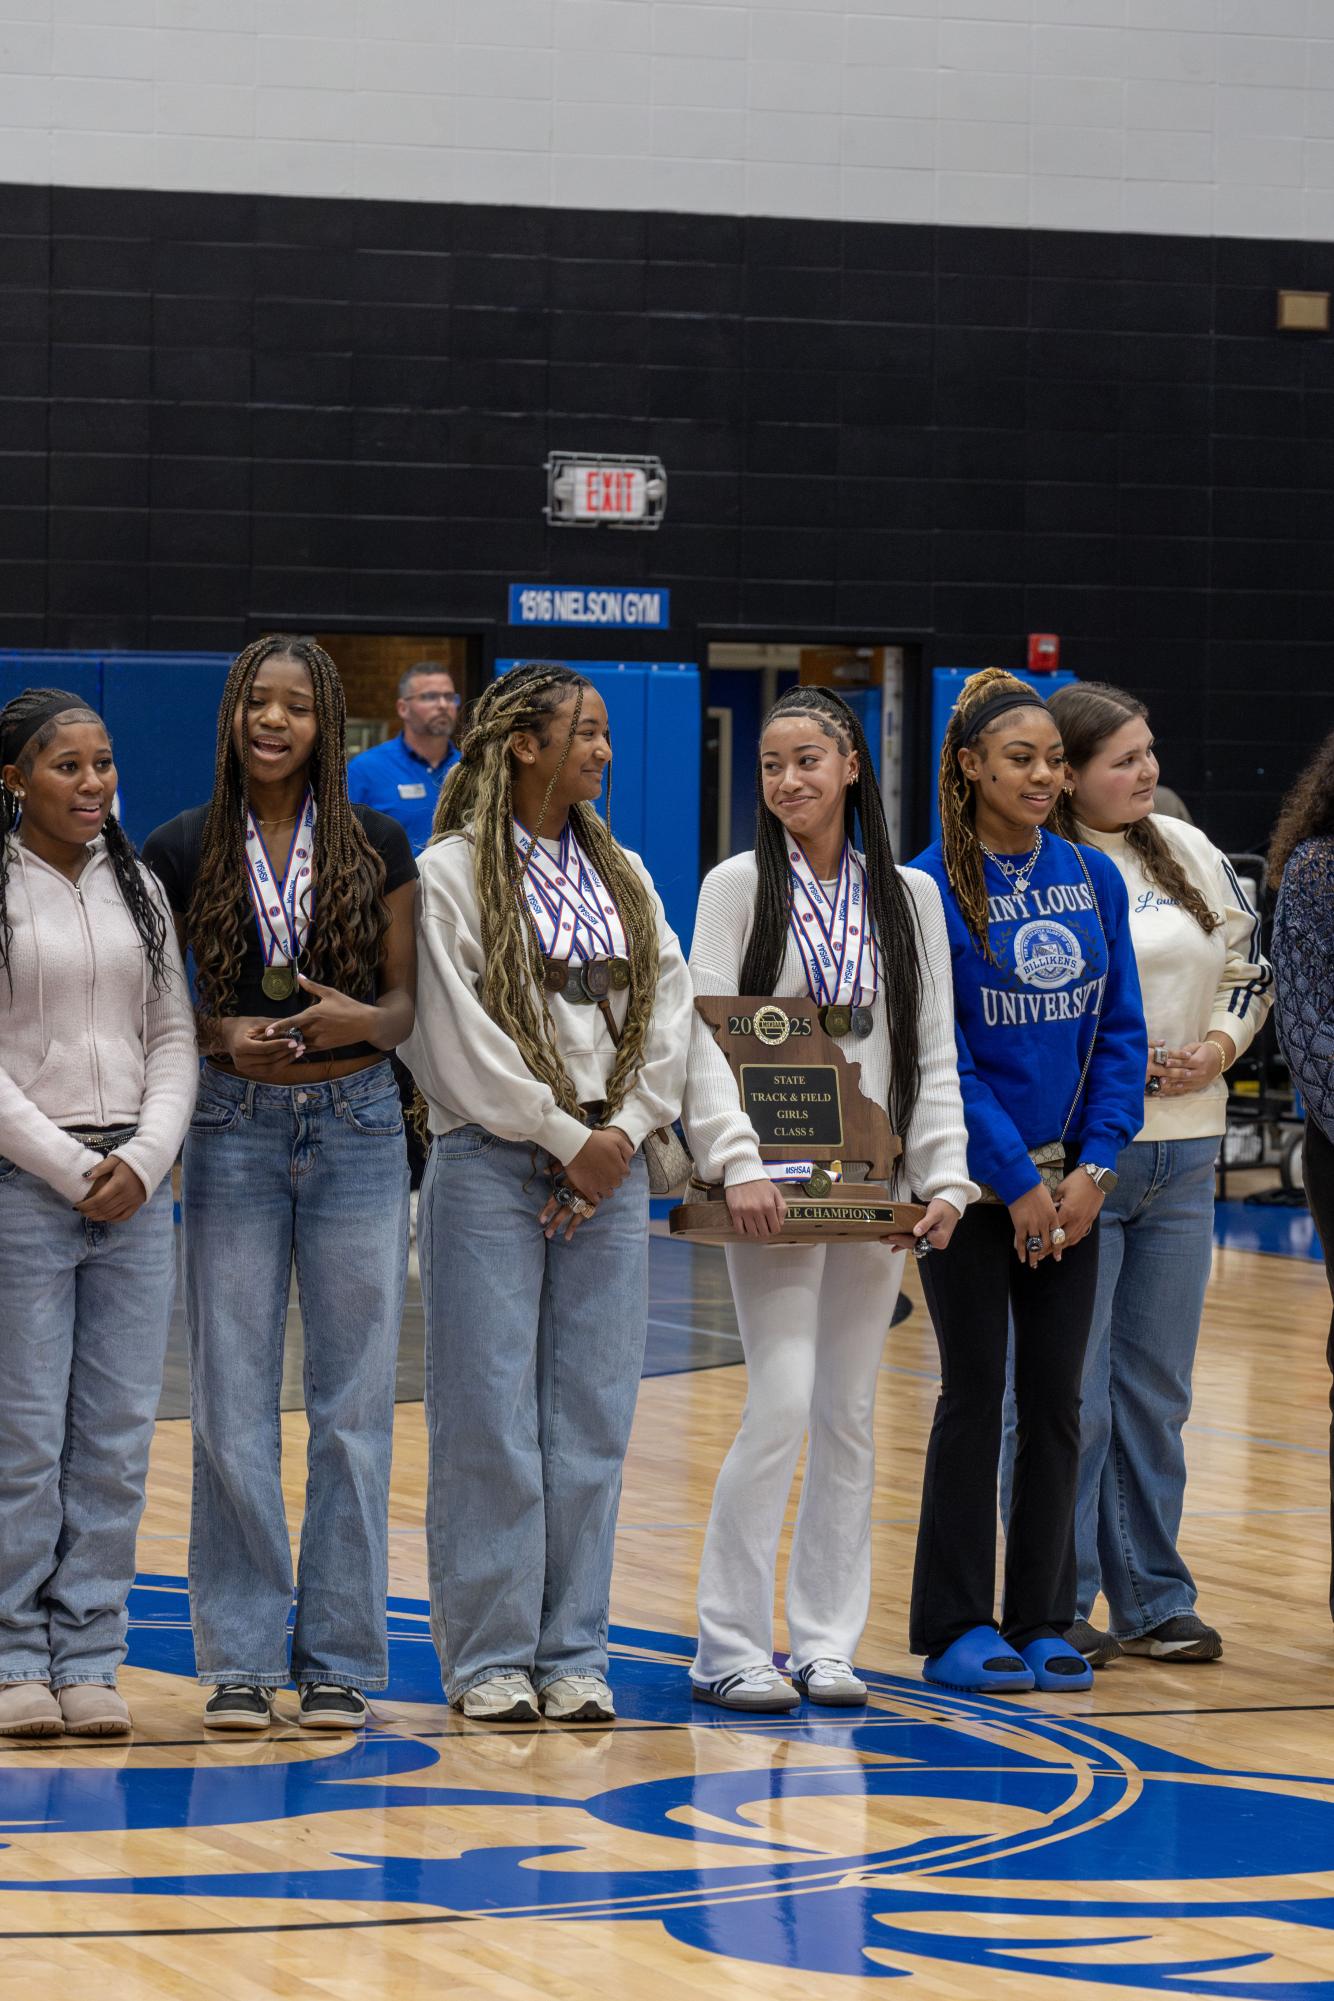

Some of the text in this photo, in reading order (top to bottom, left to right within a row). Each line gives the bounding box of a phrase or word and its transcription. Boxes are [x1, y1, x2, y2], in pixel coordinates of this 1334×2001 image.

[585, 471, 636, 513] EXIT
[553, 590, 622, 622] NELSON
[623, 592, 660, 624] GYM
[519, 836, 541, 859] MSSAA
[808, 881, 824, 904] MSHSAA
[852, 882, 860, 905] MSHSAA
[988, 883, 1094, 923] INT LOUIS
[578, 903, 599, 925] MSHSAA
[817, 943, 831, 968] MSHSAA
[1023, 956, 1077, 974] BILLIKENS
[844, 959, 854, 984] MSHSAA
[729, 1016, 752, 1035] 20
[790, 1017, 812, 1036] 25
[774, 1075, 806, 1085] STATE
[750, 1092, 832, 1102] TRACK & FIELD
[777, 1110, 809, 1119] GIRLS
[774, 1127, 815, 1137] CLASS 5
[785, 1166, 811, 1174] MSHSAA
[804, 1207, 876, 1220] CHAMPIONS
